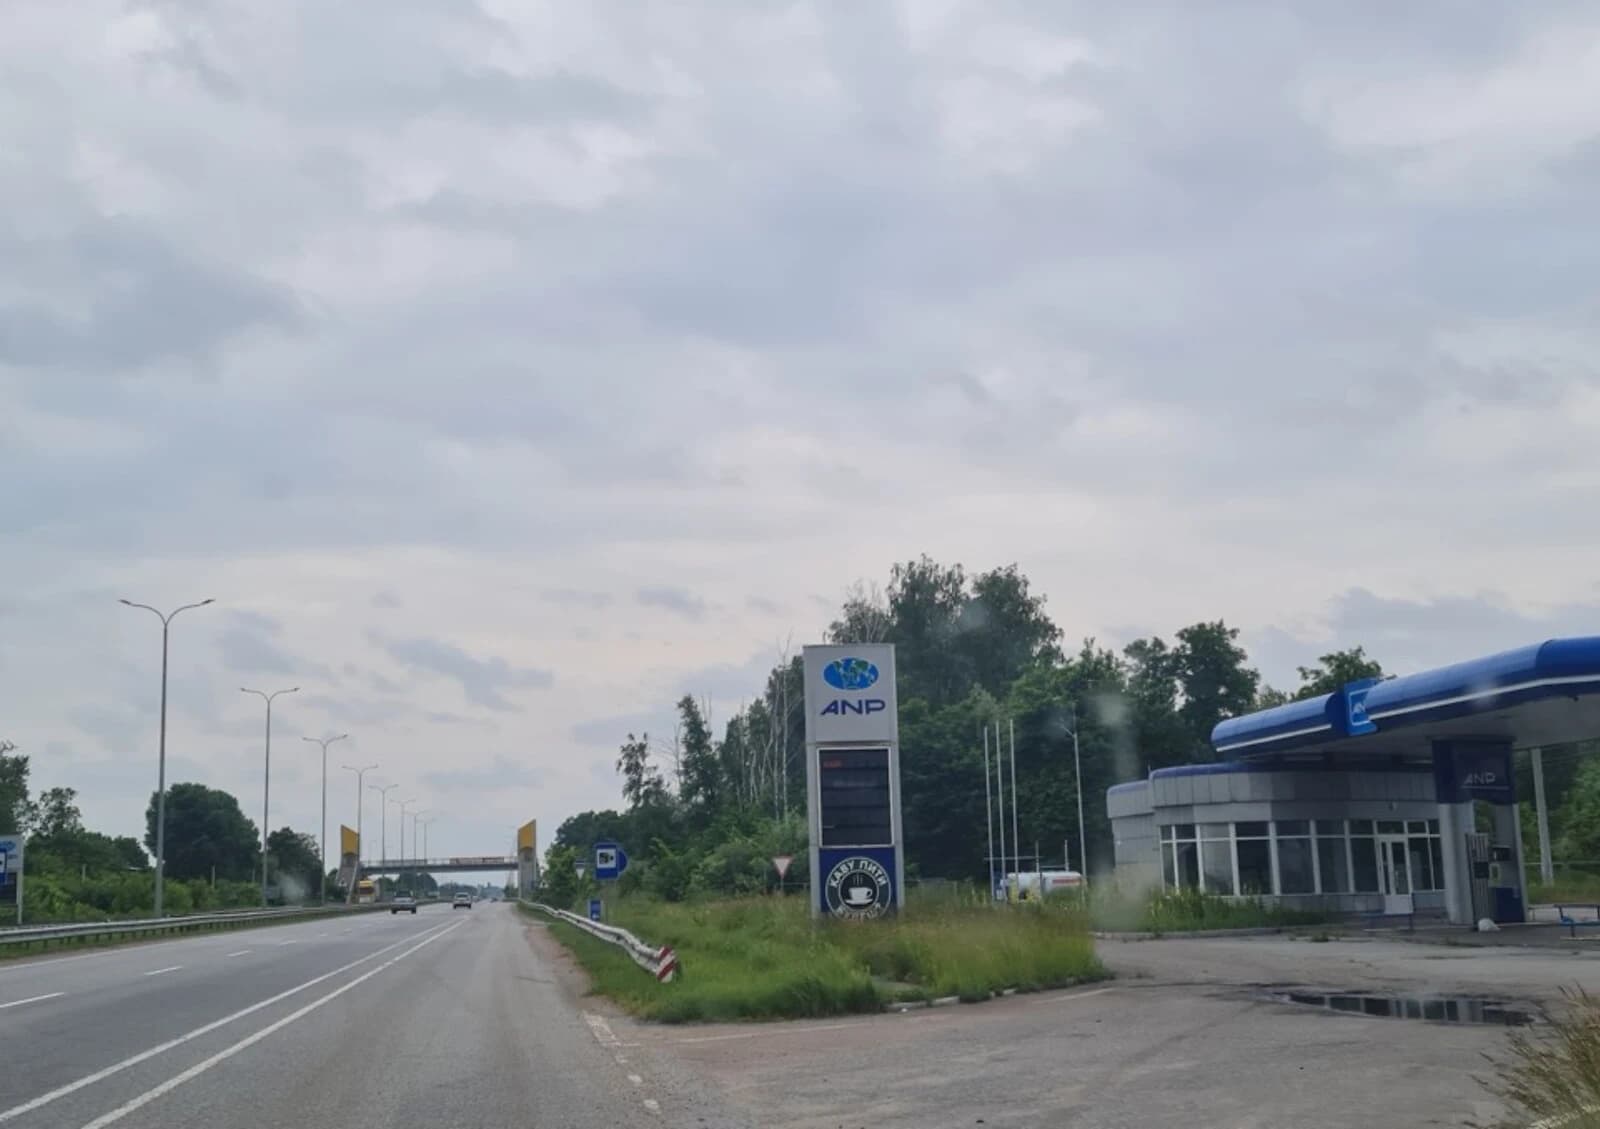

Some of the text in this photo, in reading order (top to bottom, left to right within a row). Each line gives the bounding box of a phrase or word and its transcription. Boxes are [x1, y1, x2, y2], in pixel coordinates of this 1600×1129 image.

[820, 699, 886, 716] ANP
[1463, 771, 1497, 785] ANP
[830, 860, 887, 888] КАВУ ПИТИ
